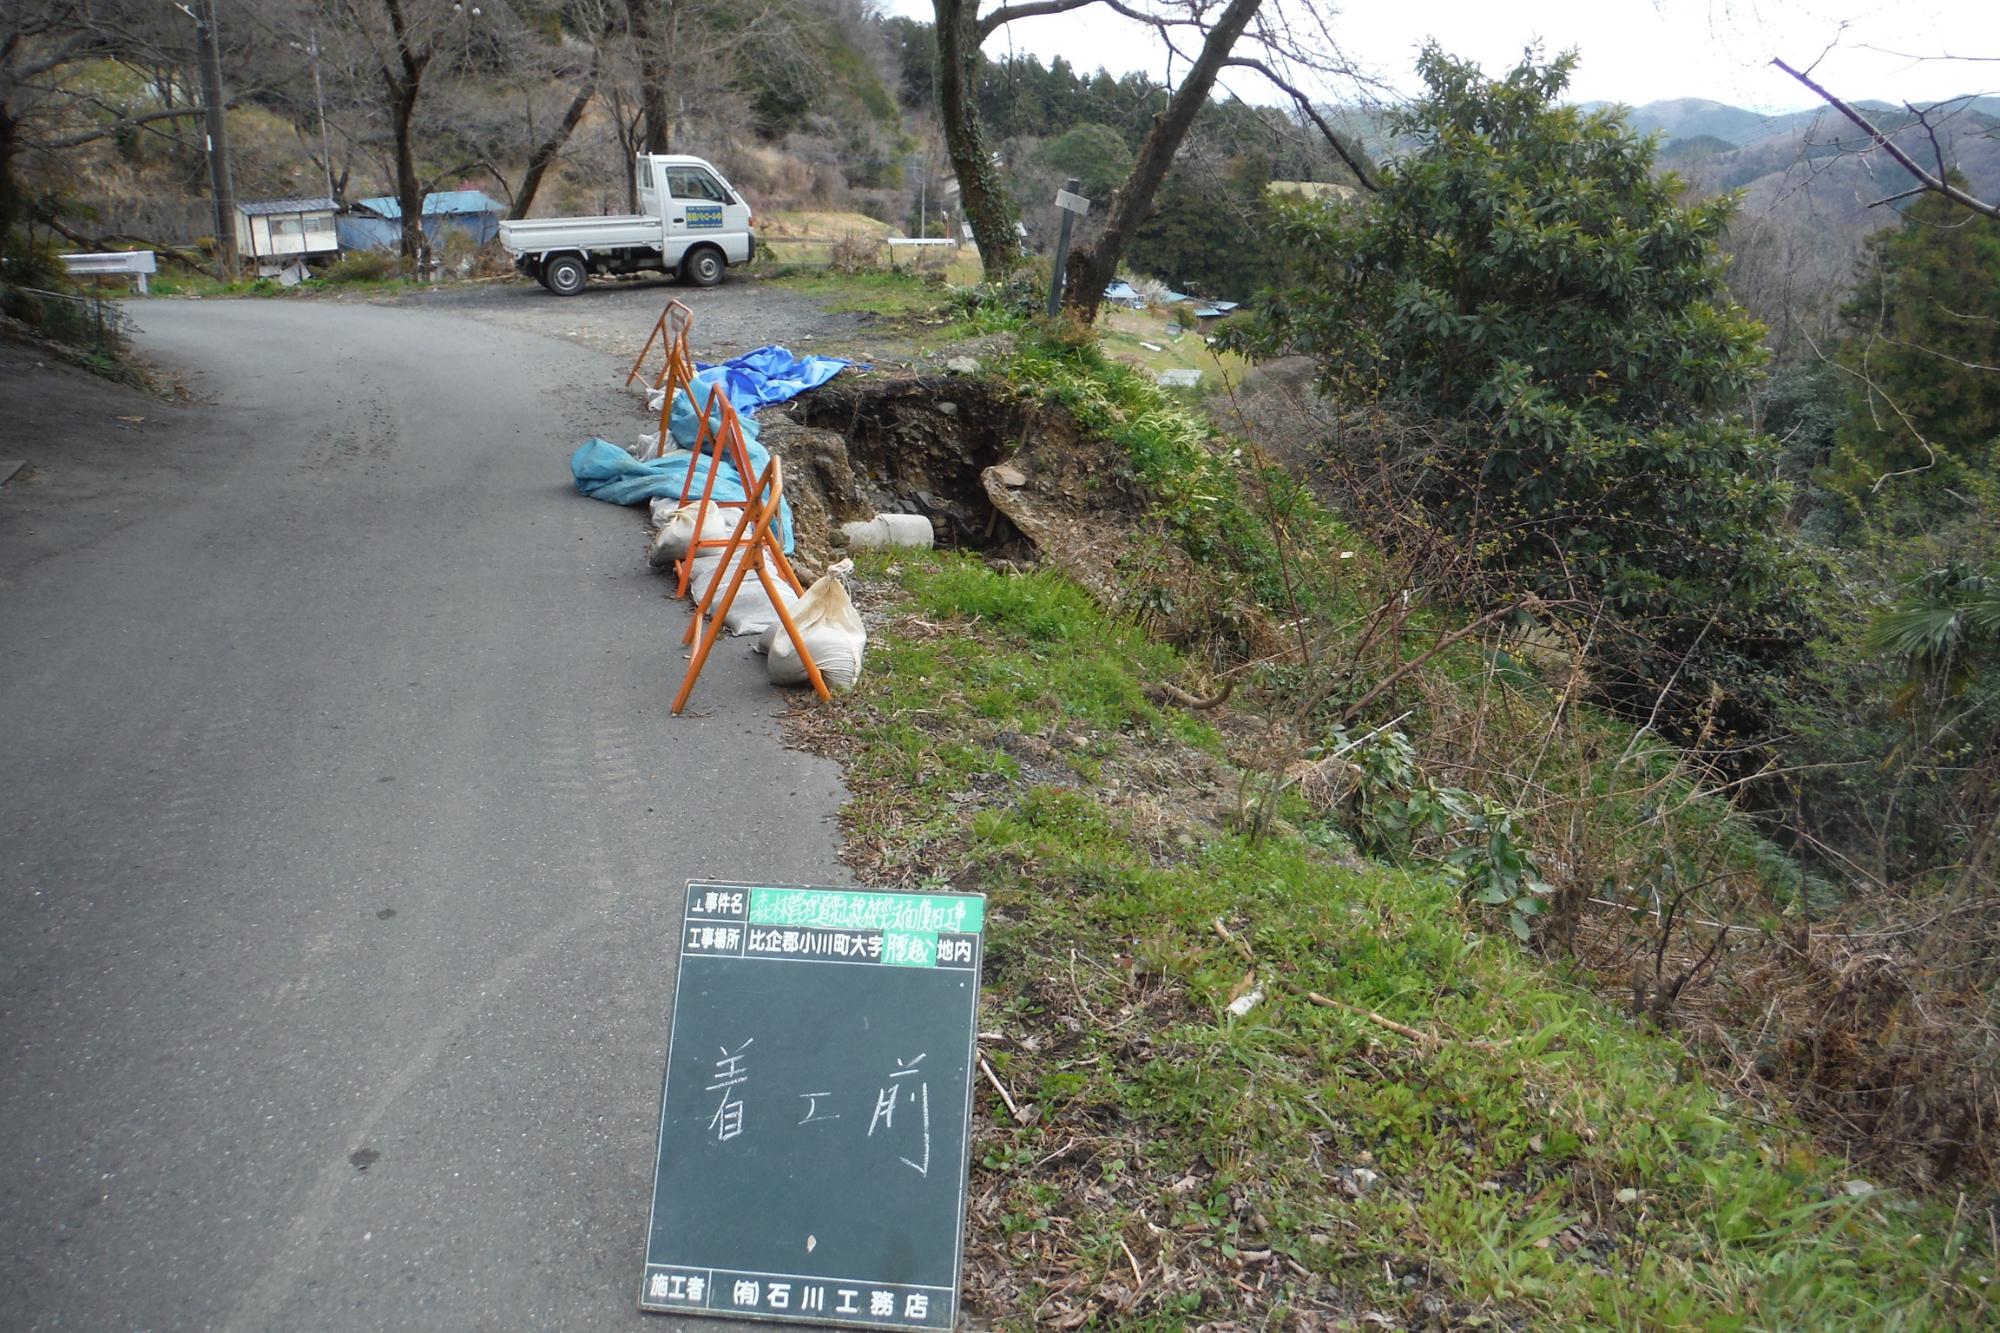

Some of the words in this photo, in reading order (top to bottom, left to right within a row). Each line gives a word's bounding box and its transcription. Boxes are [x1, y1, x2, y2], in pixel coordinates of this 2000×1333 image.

[692, 891, 743, 914] 工事件名
[689, 927, 741, 950] 工事場所
[705, 1037, 930, 1178] 着工前
[650, 1273, 705, 1301] 施工者
